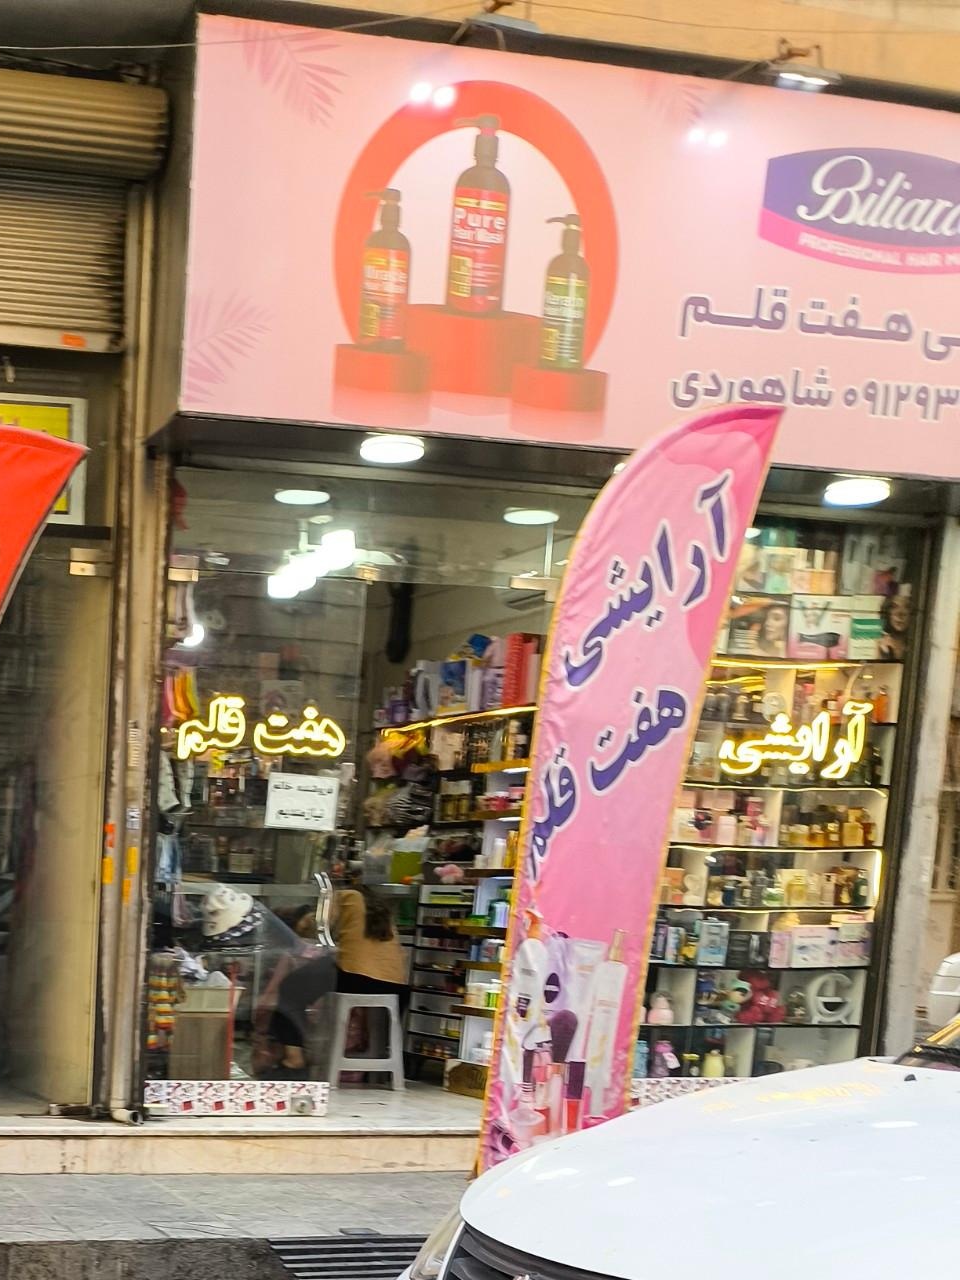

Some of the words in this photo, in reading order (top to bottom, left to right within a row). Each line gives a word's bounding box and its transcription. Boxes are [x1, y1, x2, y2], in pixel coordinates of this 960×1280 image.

[453, 207, 506, 231] Pure
[679, 286, 788, 337] قلم
[799, 296, 913, 342] هفت
[671, 367, 833, 408] شاهوردی
[565, 472, 732, 687] آرایشی
[177, 696, 247, 760] قلم
[253, 706, 346, 757] هفت
[590, 689, 687, 793] هفت
[718, 700, 874, 779] آرایشی
[529, 746, 577, 880] قلم
